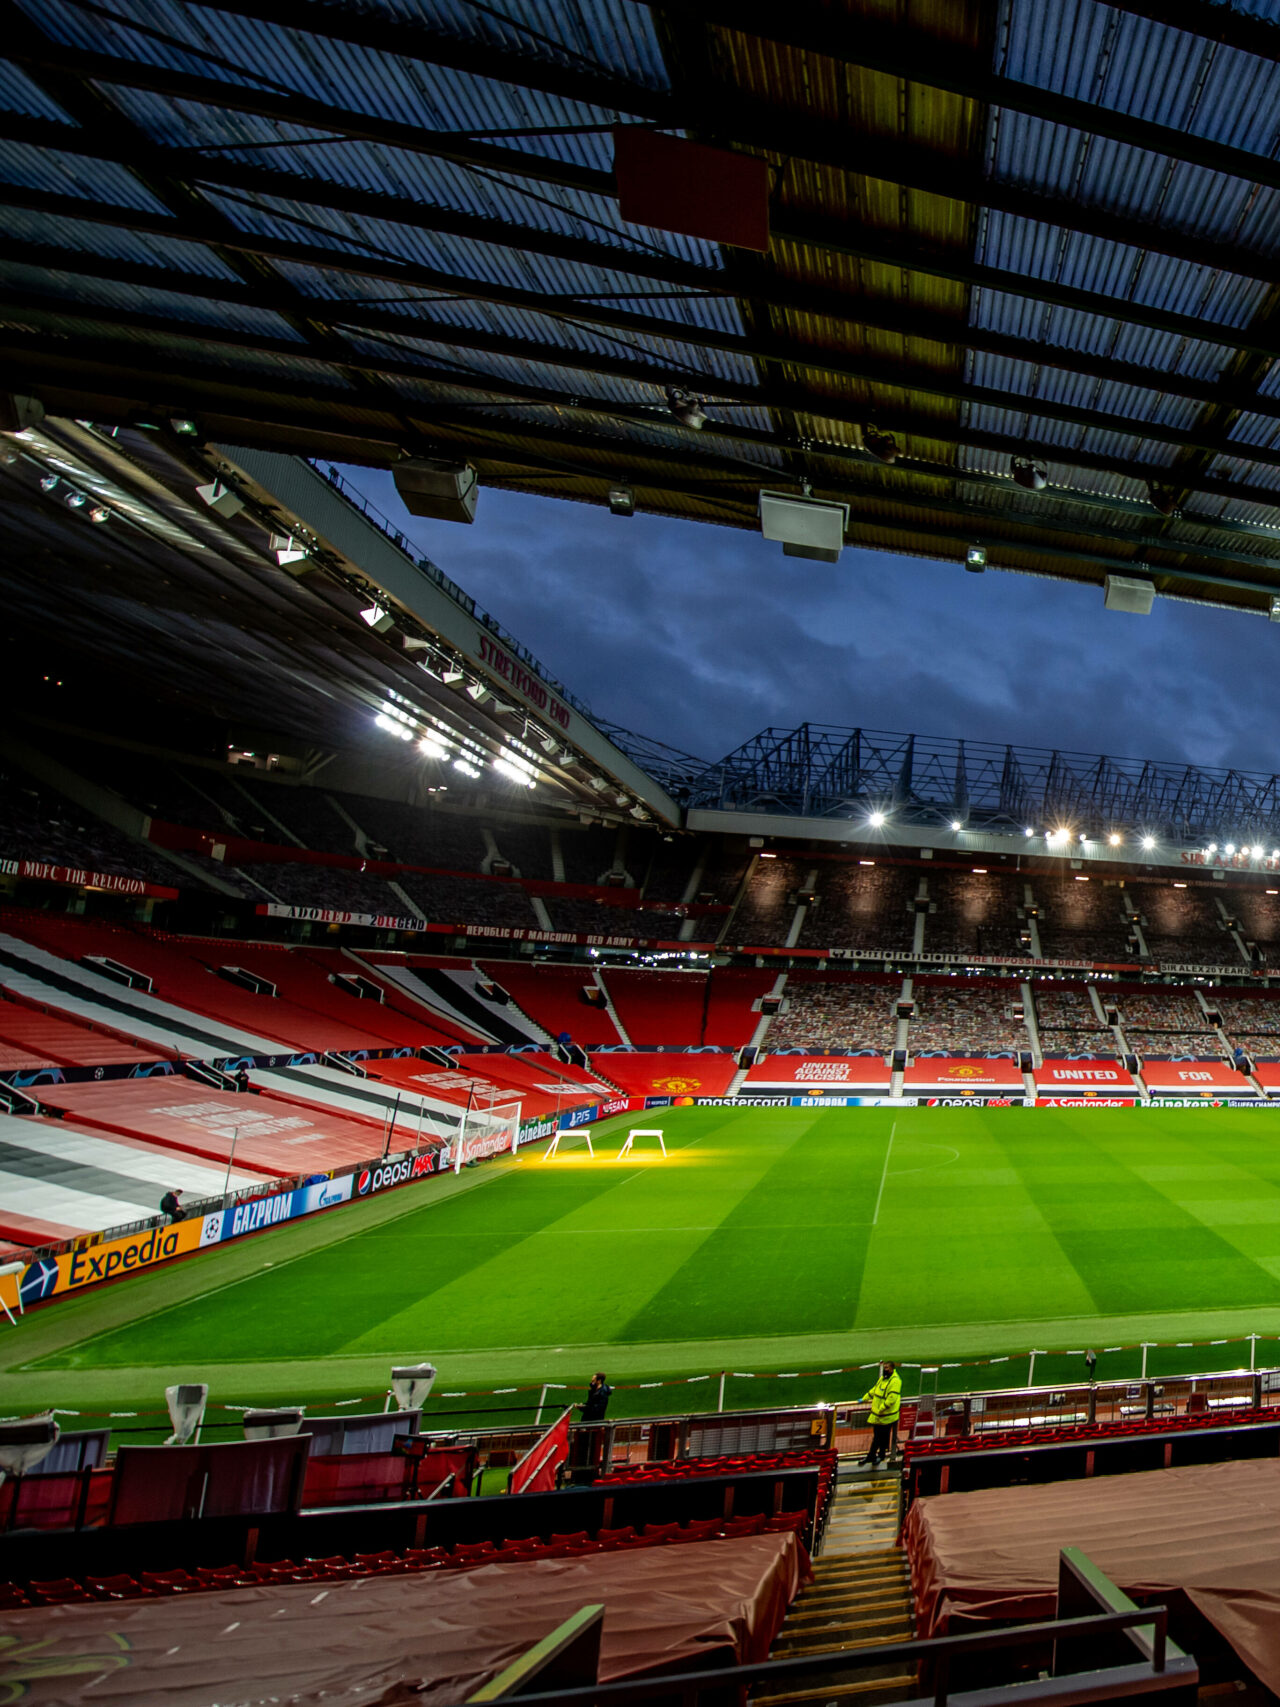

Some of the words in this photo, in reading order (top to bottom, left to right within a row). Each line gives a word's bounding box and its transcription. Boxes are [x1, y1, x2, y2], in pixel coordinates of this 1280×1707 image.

[479, 635, 548, 710] STRETFORD
[549, 698, 570, 729] END
[1181, 852, 1205, 865] SIR
[1213, 855, 1249, 868] ALEX
[24, 861, 60, 880] MUFC
[65, 867, 87, 885] THE
[92, 872, 147, 894] RELIGION
[287, 906, 352, 923] ADORED
[466, 925, 510, 938] REPUBLIC
[513, 929, 525, 939] OF
[528, 931, 577, 943] MANCUNIA
[587, 935, 604, 945] RED
[606, 936, 634, 947] ARMY
[967, 955, 989, 963] THE
[991, 956, 1054, 966] IMPOSSIBLE
[1058, 959, 1094, 968] DREAM
[1161, 964, 1177, 973] SIR
[1179, 964, 1204, 973] ALEX
[1217, 966, 1250, 975] YEARS
[1053, 1069, 1118, 1080] UNITED
[1178, 1071, 1214, 1081] FOR
[697, 1097, 788, 1106] mastercard
[987, 1099, 1013, 1107] MAX
[1059, 1099, 1124, 1107] Santander
[577, 1110, 590, 1123] PS5
[519, 1120, 551, 1144] eineken
[466, 1133, 507, 1159] Santander
[372, 1158, 412, 1192] pepsi
[412, 1152, 437, 1176] MAX
[232, 1192, 294, 1235] GAZPROM
[69, 1227, 179, 1287] Expedia
[815, 1425, 822, 1434] 2
